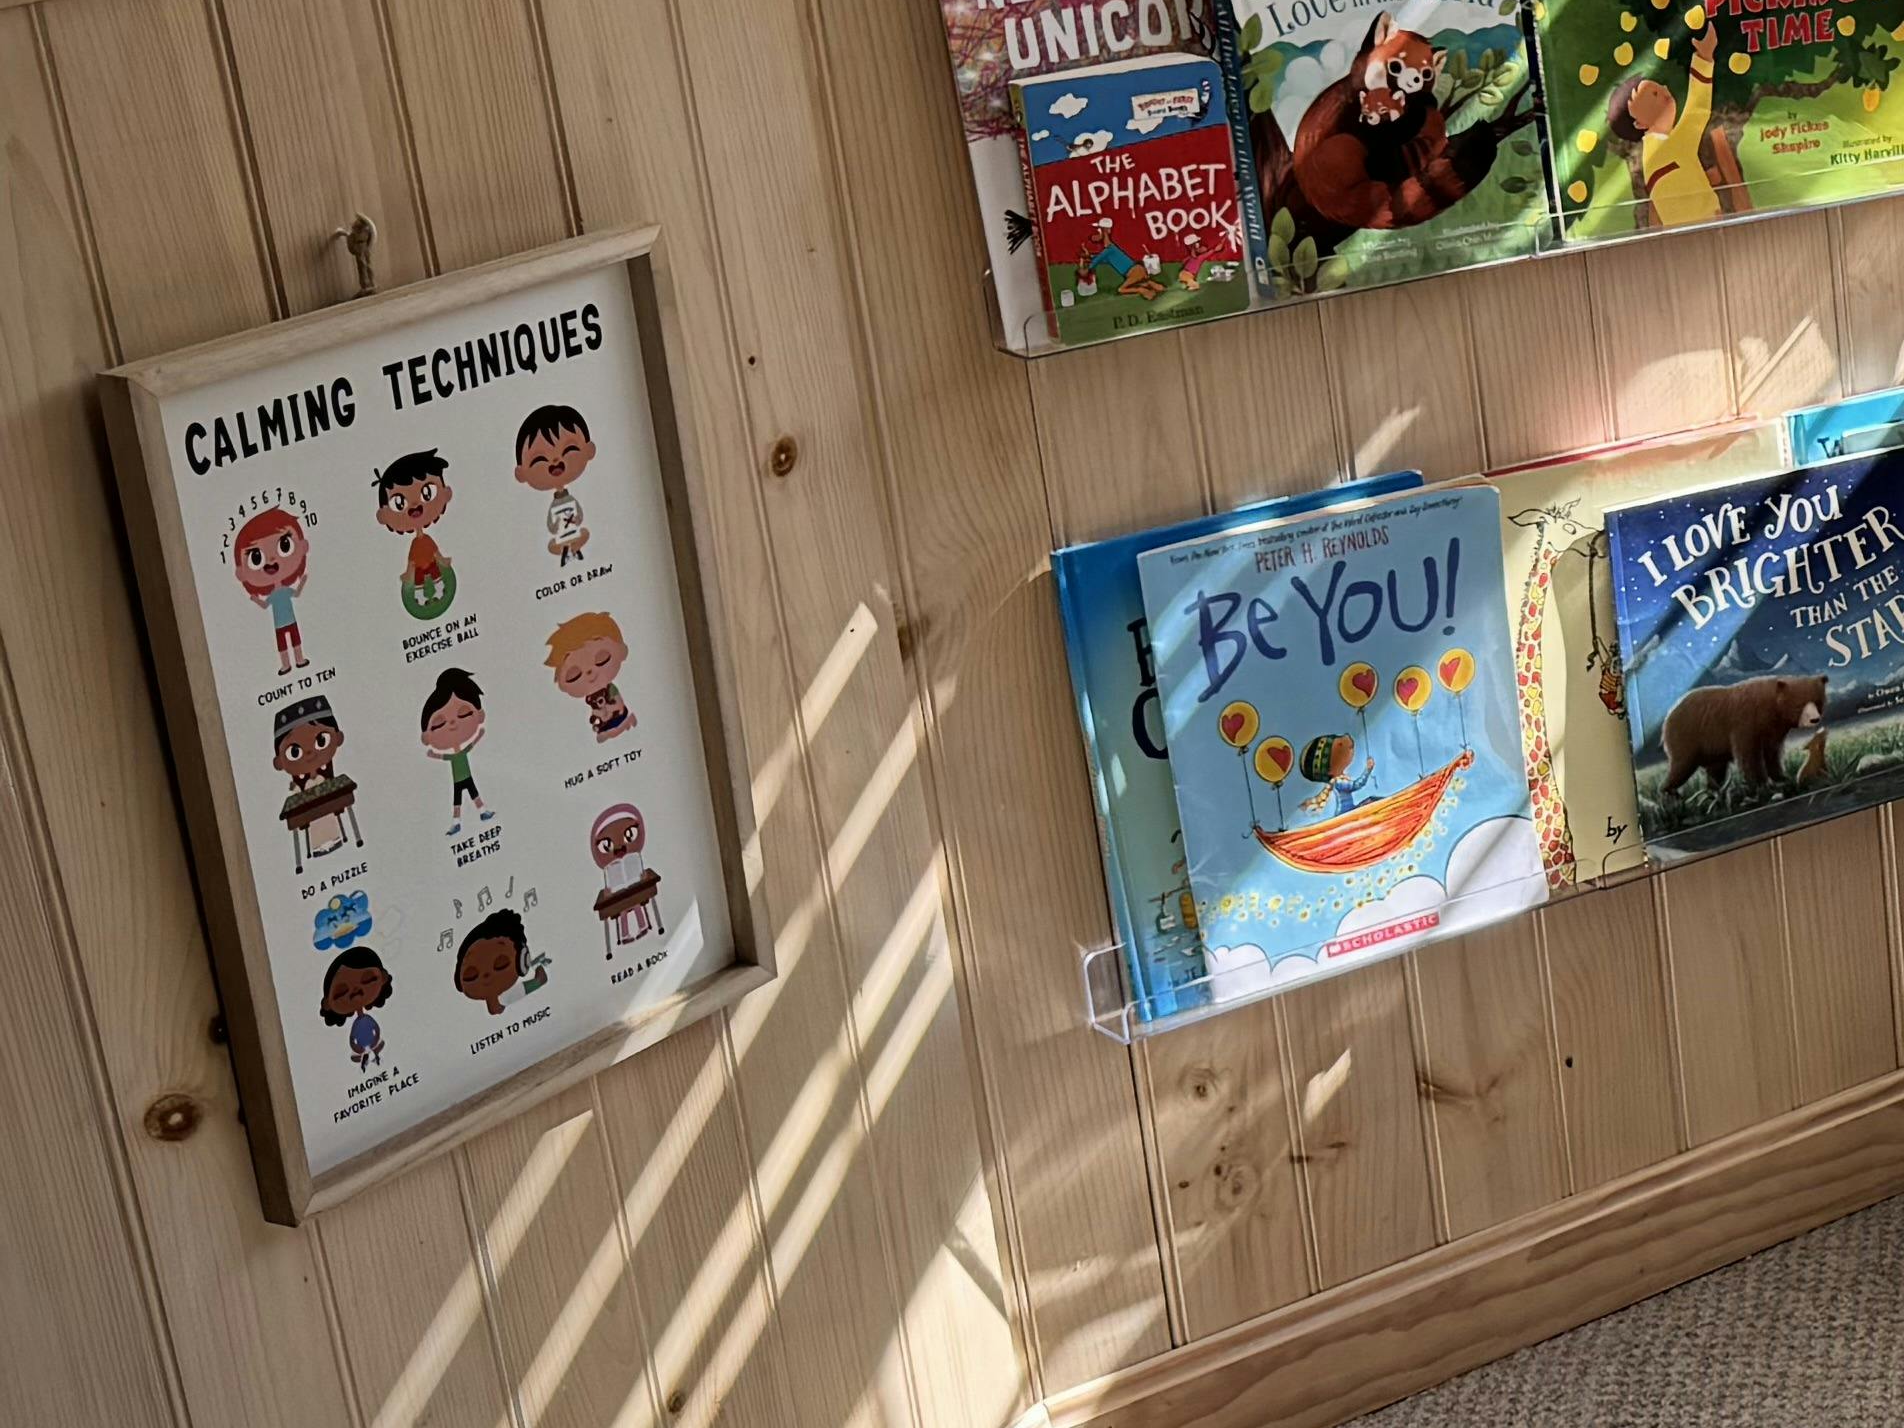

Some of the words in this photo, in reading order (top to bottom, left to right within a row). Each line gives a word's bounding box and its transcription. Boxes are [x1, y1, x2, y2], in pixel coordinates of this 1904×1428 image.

[1740, 9, 1834, 53] TIME
[1090, 152, 1135, 175] THE
[1045, 163, 1227, 223] ALPHABET
[1145, 200, 1232, 242] BOOK
[1146, 303, 1205, 324] Eastman
[184, 376, 357, 476] CALMING
[382, 302, 603, 411] TECHNIQUES
[1255, 543, 1296, 573] PETER
[1323, 525, 1390, 559] REYNOLDS
[1638, 550, 1668, 587] I
[1662, 502, 1750, 572] LOVE
[1764, 484, 1843, 540] YOU
[1790, 592, 1848, 628] THAN
[1853, 565, 1899, 602] THE
[402, 627, 442, 650] BOUNCE
[445, 620, 460, 633] ON
[463, 613, 478, 626] AN
[1184, 590, 1288, 704] Be
[1290, 536, 1461, 666] YOU!
[405, 637, 453, 663] EXERCISE
[457, 627, 479, 644] BALL
[257, 683, 293, 706] COUNT
[297, 677, 312, 690] TO
[315, 667, 336, 682] TEN
[301, 886, 315, 899] DO
[320, 881, 327, 891] A
[331, 862, 368, 886] PUZZLE
[1341, 915, 1438, 952] SCHOLASTIC
